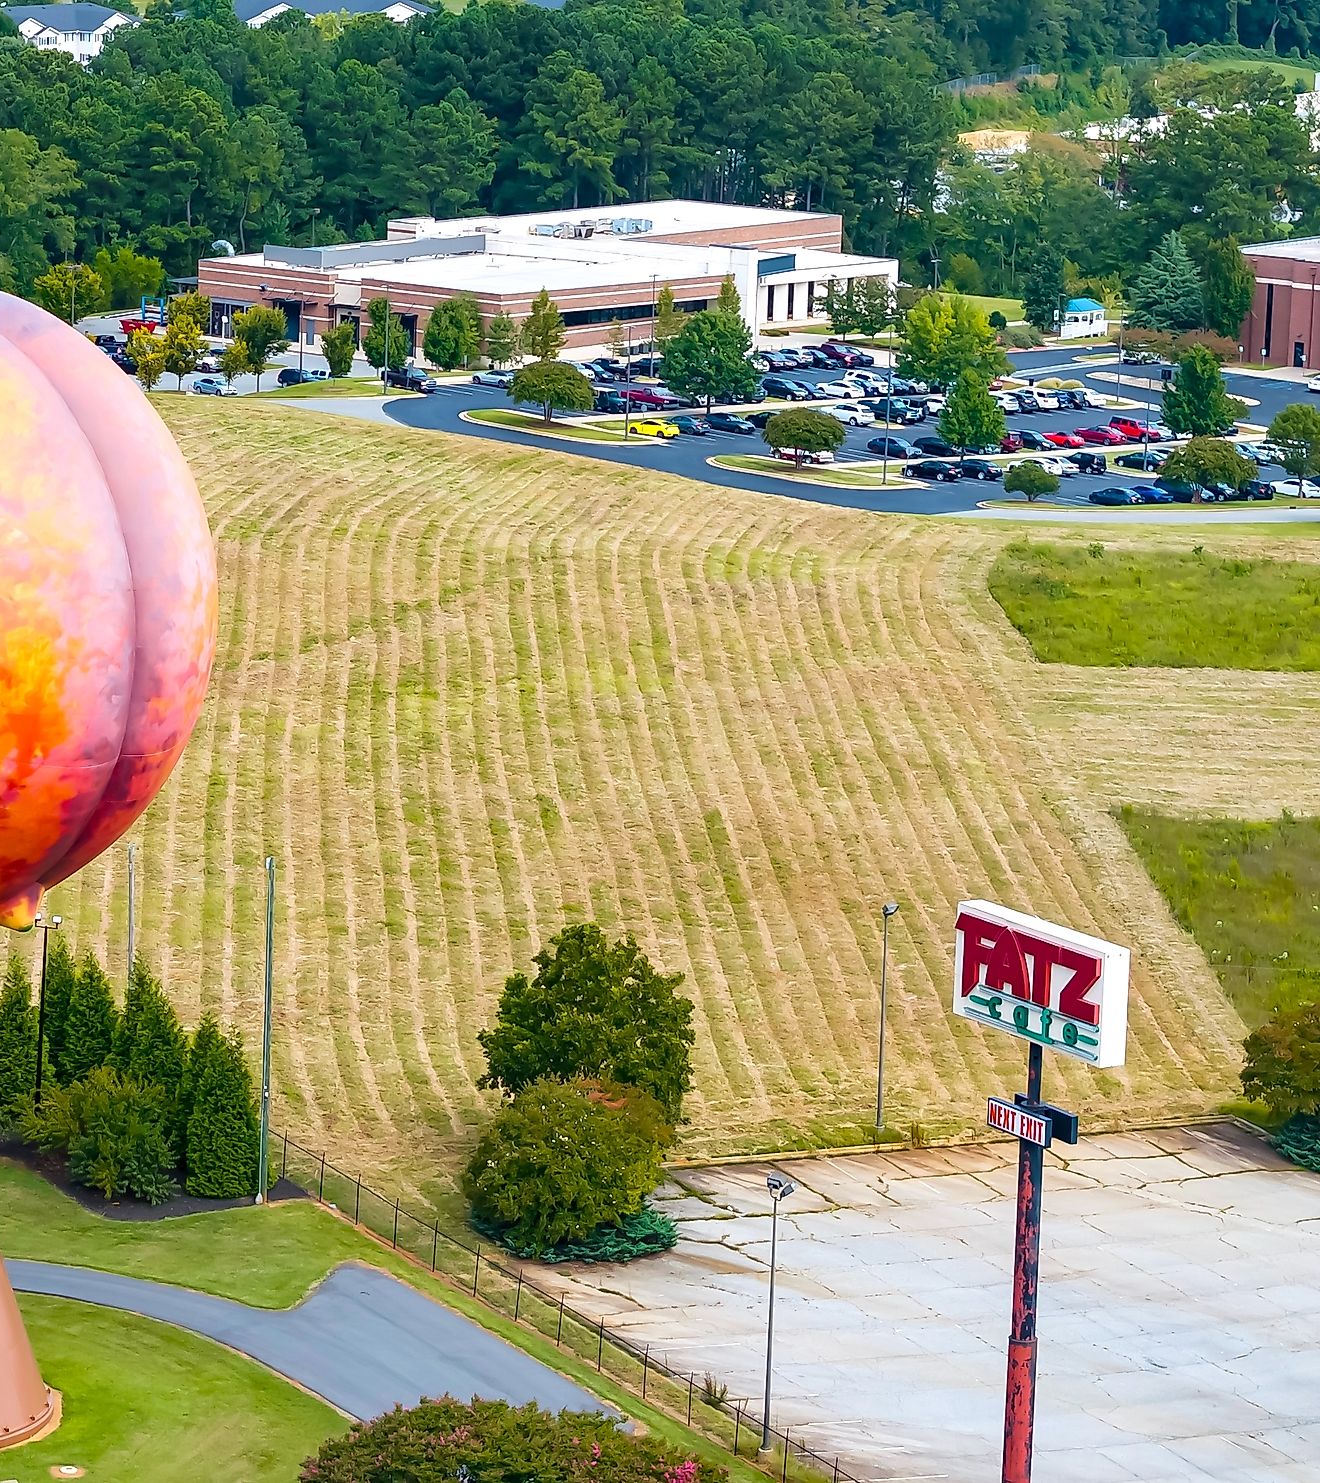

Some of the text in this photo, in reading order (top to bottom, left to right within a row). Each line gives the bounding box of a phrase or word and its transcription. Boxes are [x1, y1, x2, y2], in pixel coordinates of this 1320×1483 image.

[955, 912, 1102, 1026] FATZ
[986, 996, 1079, 1044] cafe
[989, 1102, 1043, 1143] NEXT EXIT
